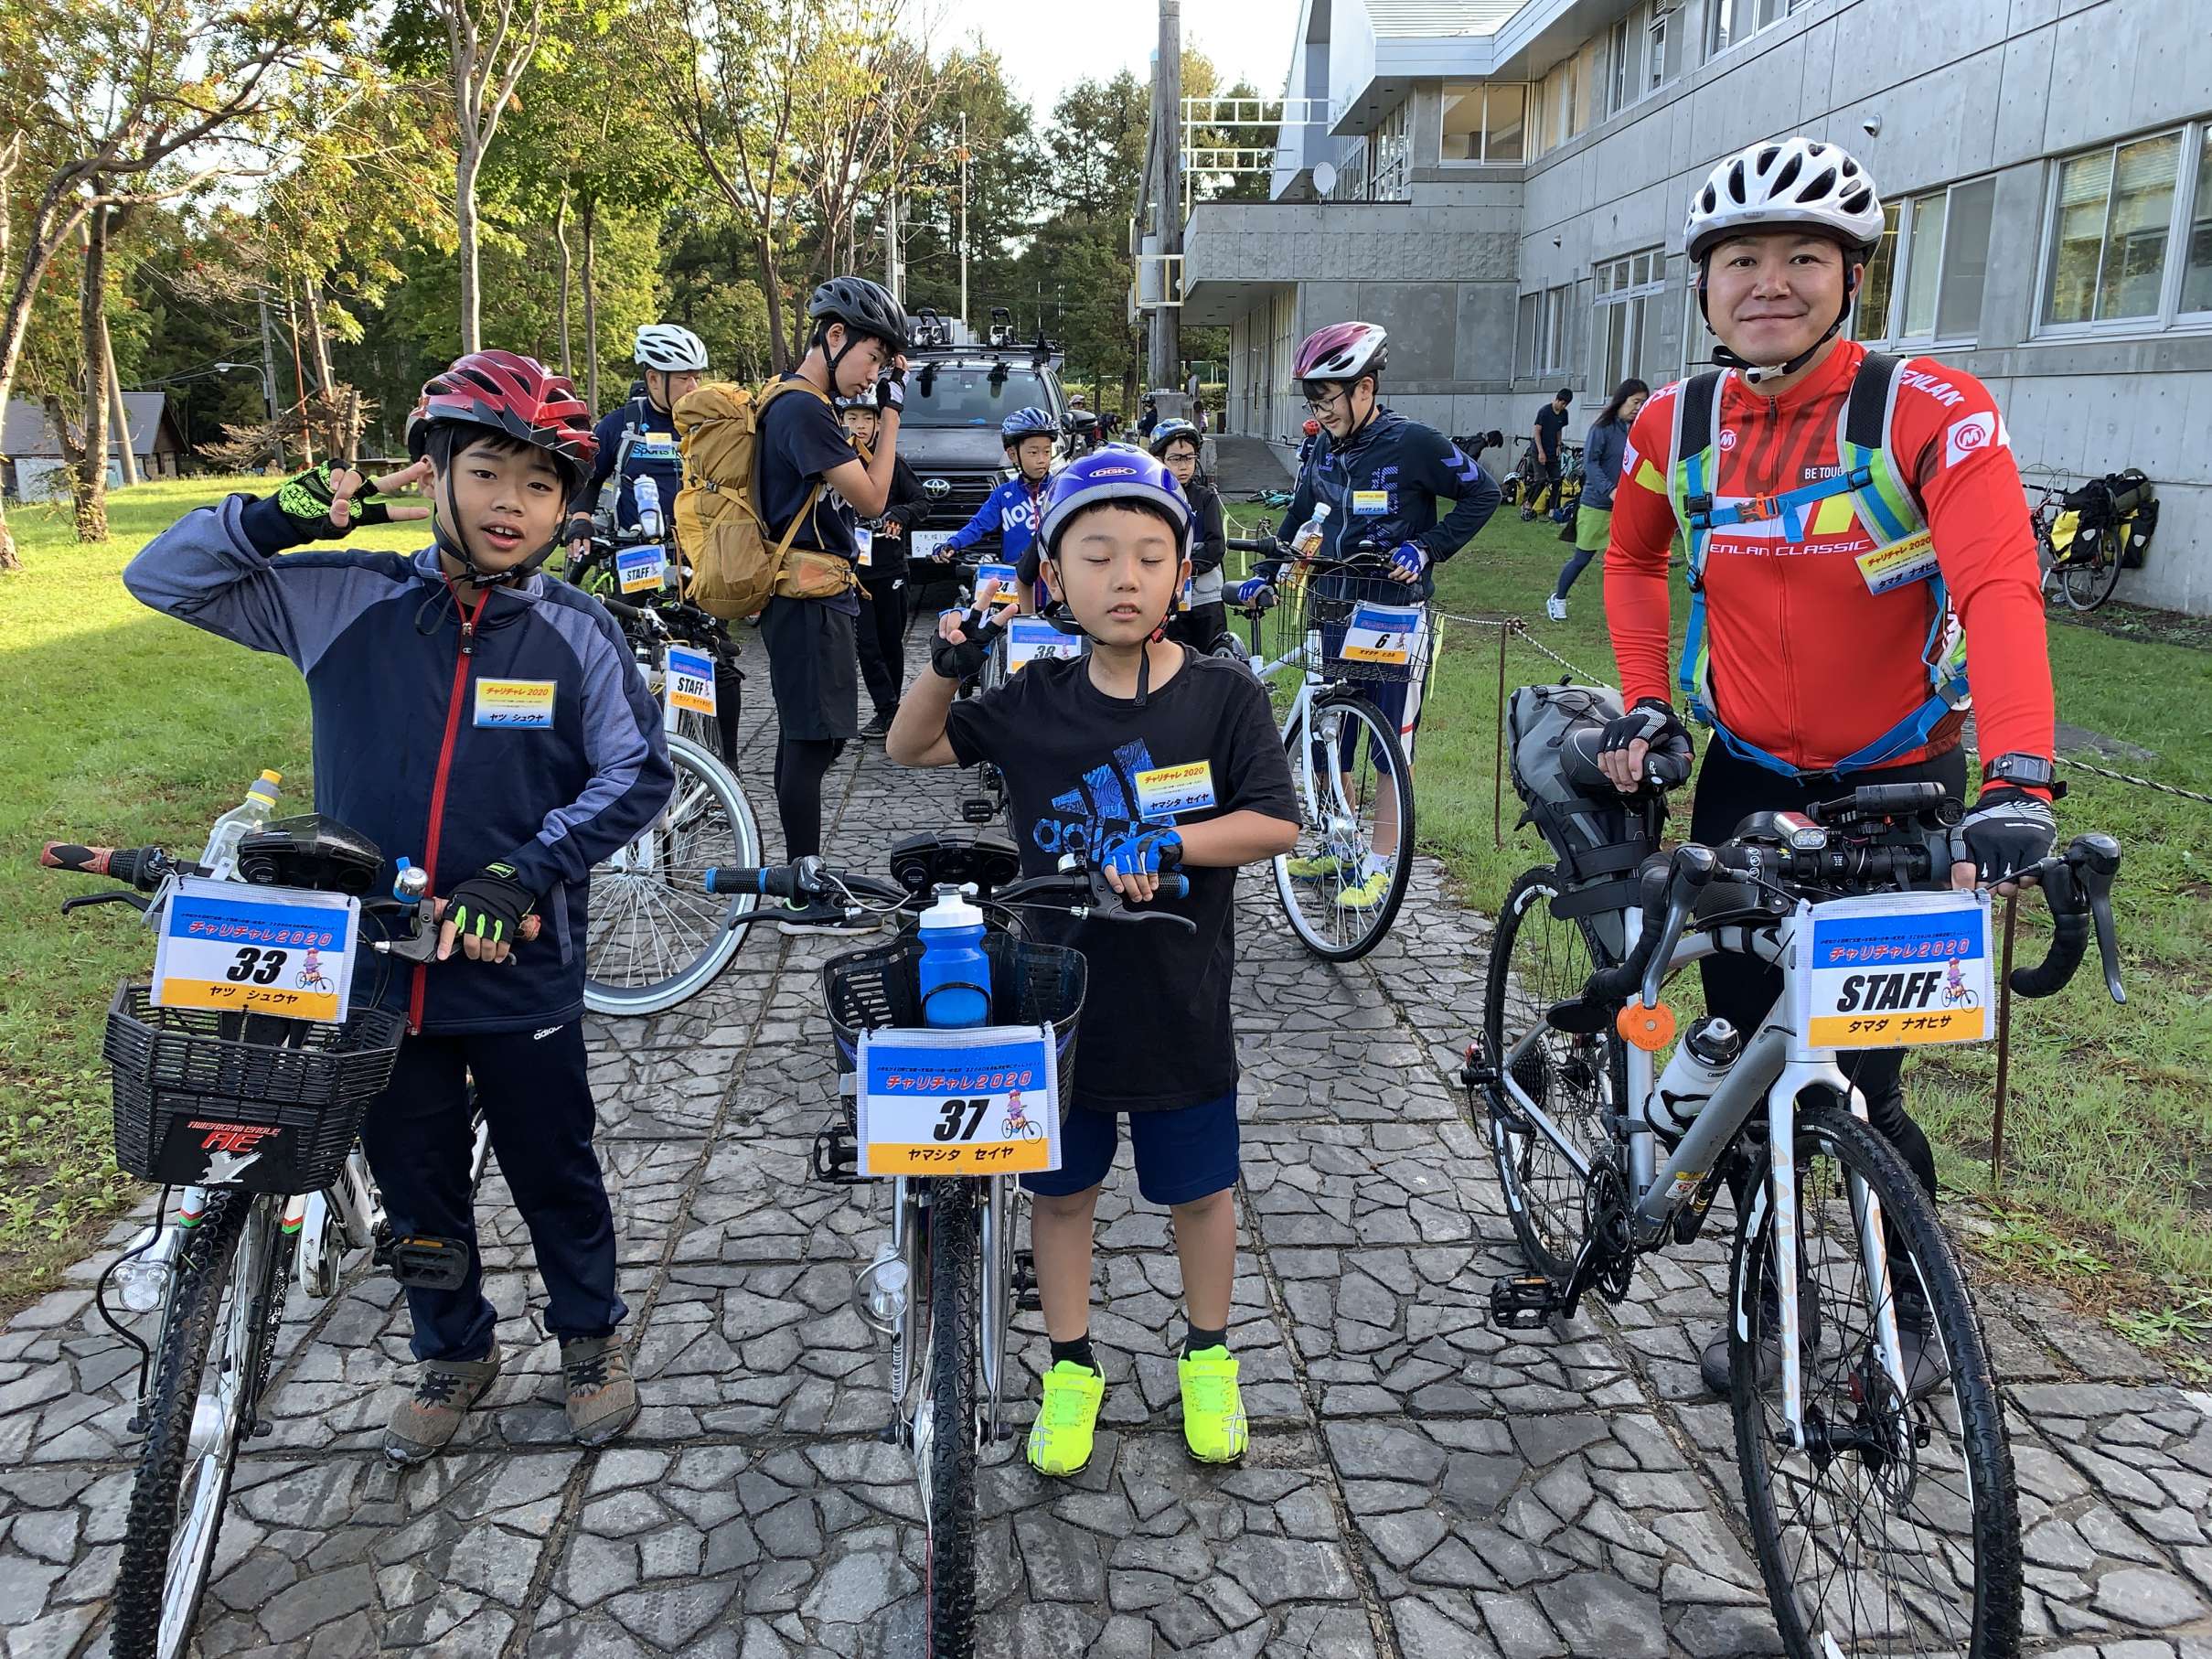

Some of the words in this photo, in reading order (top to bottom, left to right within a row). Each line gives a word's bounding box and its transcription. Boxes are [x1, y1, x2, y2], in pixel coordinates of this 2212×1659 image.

[1805, 467, 1817, 479] BE
[1819, 466, 1843, 478] TOUG
[1709, 544, 1769, 557] ENLAN
[1775, 540, 1871, 556] CLASSIC
[1866, 547, 1907, 567] チャリチャレ
[1908, 537, 1931, 551] 2020
[627, 567, 649, 581] STAFF
[1374, 634, 1390, 648] 6
[486, 687, 526, 695] チャリチャレ
[527, 688, 549, 696] 2020
[678, 677, 703, 696] STAFF
[490, 713, 508, 722] ヤツ
[1144, 771, 1182, 784] チャリチャレ
[1183, 766, 1204, 777] 2020
[1149, 798, 1181, 810] ヤマシタ
[1185, 794, 1209, 804] セイヤ
[226, 947, 287, 984] 33
[209, 986, 236, 997] ヤツ
[247, 990, 298, 1004] シュウヤ
[1836, 970, 1942, 1012] STAFF
[1847, 1019, 1890, 1033] タマダ
[1902, 1015, 1952, 1031] ナオヒサ
[933, 1098, 990, 1140] 37
[908, 1148, 961, 1161] ヤマシタ
[975, 1146, 1014, 1161] セイヤ
